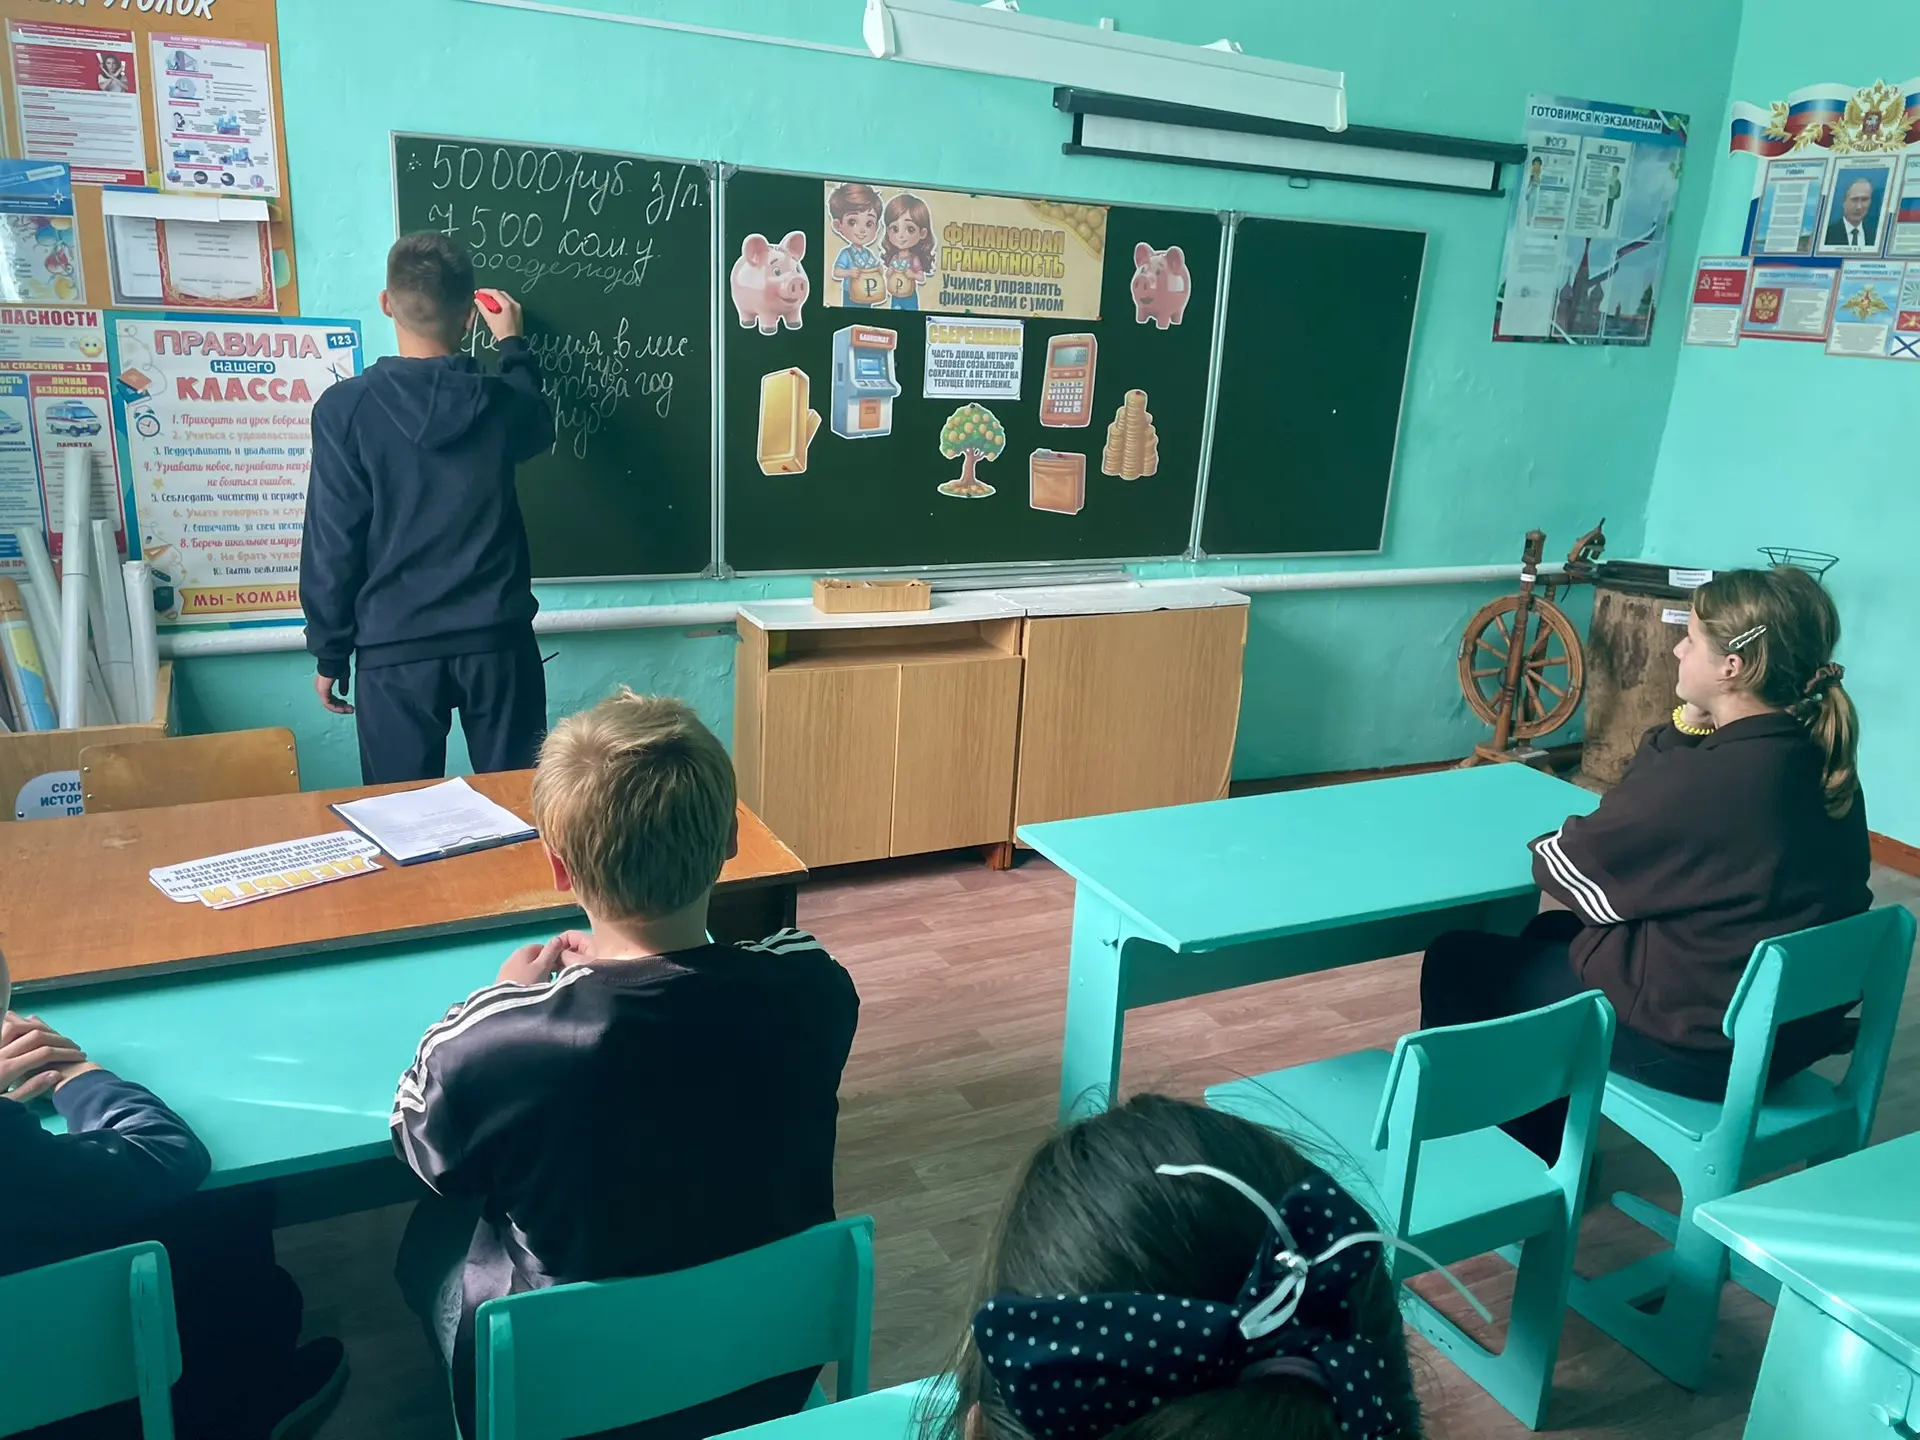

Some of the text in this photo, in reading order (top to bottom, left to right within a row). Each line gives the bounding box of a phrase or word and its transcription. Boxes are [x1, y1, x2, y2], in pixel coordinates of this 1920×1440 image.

[1531, 105, 1662, 131] ГОТОВИМСЯ К ЭКЗАМЕНАМ
[943, 221, 1065, 255] ФИНАНСОВАЯ
[941, 246, 1065, 278] ГРАМОТНОСТЬ
[942, 273, 1062, 296] Учимся управлять
[939, 290, 1064, 311] финансами с умом
[0, 309, 98, 327] ПАСНОСТИ
[330, 334, 352, 346] 123
[859, 333, 889, 344] БАНКОМАТ
[928, 324, 1021, 346] СБЕРЕЖЕНИЯ
[154, 330, 322, 359] ПРАВИЛА
[932, 350, 954, 358] ЧАСТЬ
[986, 351, 1018, 360] КОТОРУЮ
[12, 362, 65, 371] СПАСЕНИЯ
[213, 360, 274, 373] нашего
[934, 359, 1014, 370] ЧЕЛОВЕК СОЗНАТЕЛЬНО
[969, 370, 974, 378] А
[975, 370, 984, 378] НЕ
[985, 370, 1009, 379] ТРАТИТ
[1010, 371, 1018, 379] НА
[52, 377, 87, 385] ЛИЧНАЯ
[934, 379, 1012, 389] ТЕКУЩЕЕ ПОТРЕБЛЕНИЕ.
[36, 386, 105, 395] БЕЗОПАСНОСТЬ
[176, 376, 313, 403] КЛАССА
[634, 371, 674, 418] год
[181, 413, 234, 427] Приходить
[236, 417, 248, 425] на
[249, 417, 270, 427] урок
[172, 431, 181, 440] 2.
[185, 431, 226, 440] Учиться
[164, 446, 231, 457] Поддерживать
[243, 447, 284, 456] уважать
[287, 447, 305, 457] друг
[143, 461, 152, 471] 4.
[154, 461, 203, 475] Узнавать
[234, 461, 284, 474] познавать
[286, 461, 310, 473] неизв
[207, 476, 296, 487] не бояться ошибок.
[161, 493, 214, 503] Соблюдать
[217, 493, 259, 503] чистоту
[173, 508, 183, 518] 6.
[186, 508, 218, 518] Уметь
[222, 508, 269, 518] говорить
[193, 523, 240, 532] Отвечать
[244, 523, 253, 532] за
[256, 523, 275, 531] свои
[278, 522, 304, 531] посту
[180, 537, 301, 550] 8. Беречь школьное имуще
[220, 552, 234, 560] Не
[237, 551, 267, 562] брать
[226, 566, 251, 575] Быть
[41, 794, 82, 806] ИСТОР
[67, 807, 83, 816] ПР
[295, 839, 362, 857] СТОИМОСТИ
[315, 845, 376, 863] ВСЕОБЩИЙ
[170, 836, 345, 875] ЛЕГКО НА НИХ ОБМЕНИВАЕТСЯ.
[240, 851, 294, 867] ТОВАРОВ
[191, 847, 347, 883] ВЫСТУПАЕТ ИЗМЕРИТЕЛЕМ
[213, 864, 238, 872] ИЛИ
[175, 870, 212, 881] УСЛУГ
[200, 855, 364, 904] ДЕНЬГИ
[169, 877, 231, 893] КОТОРЫЙ
